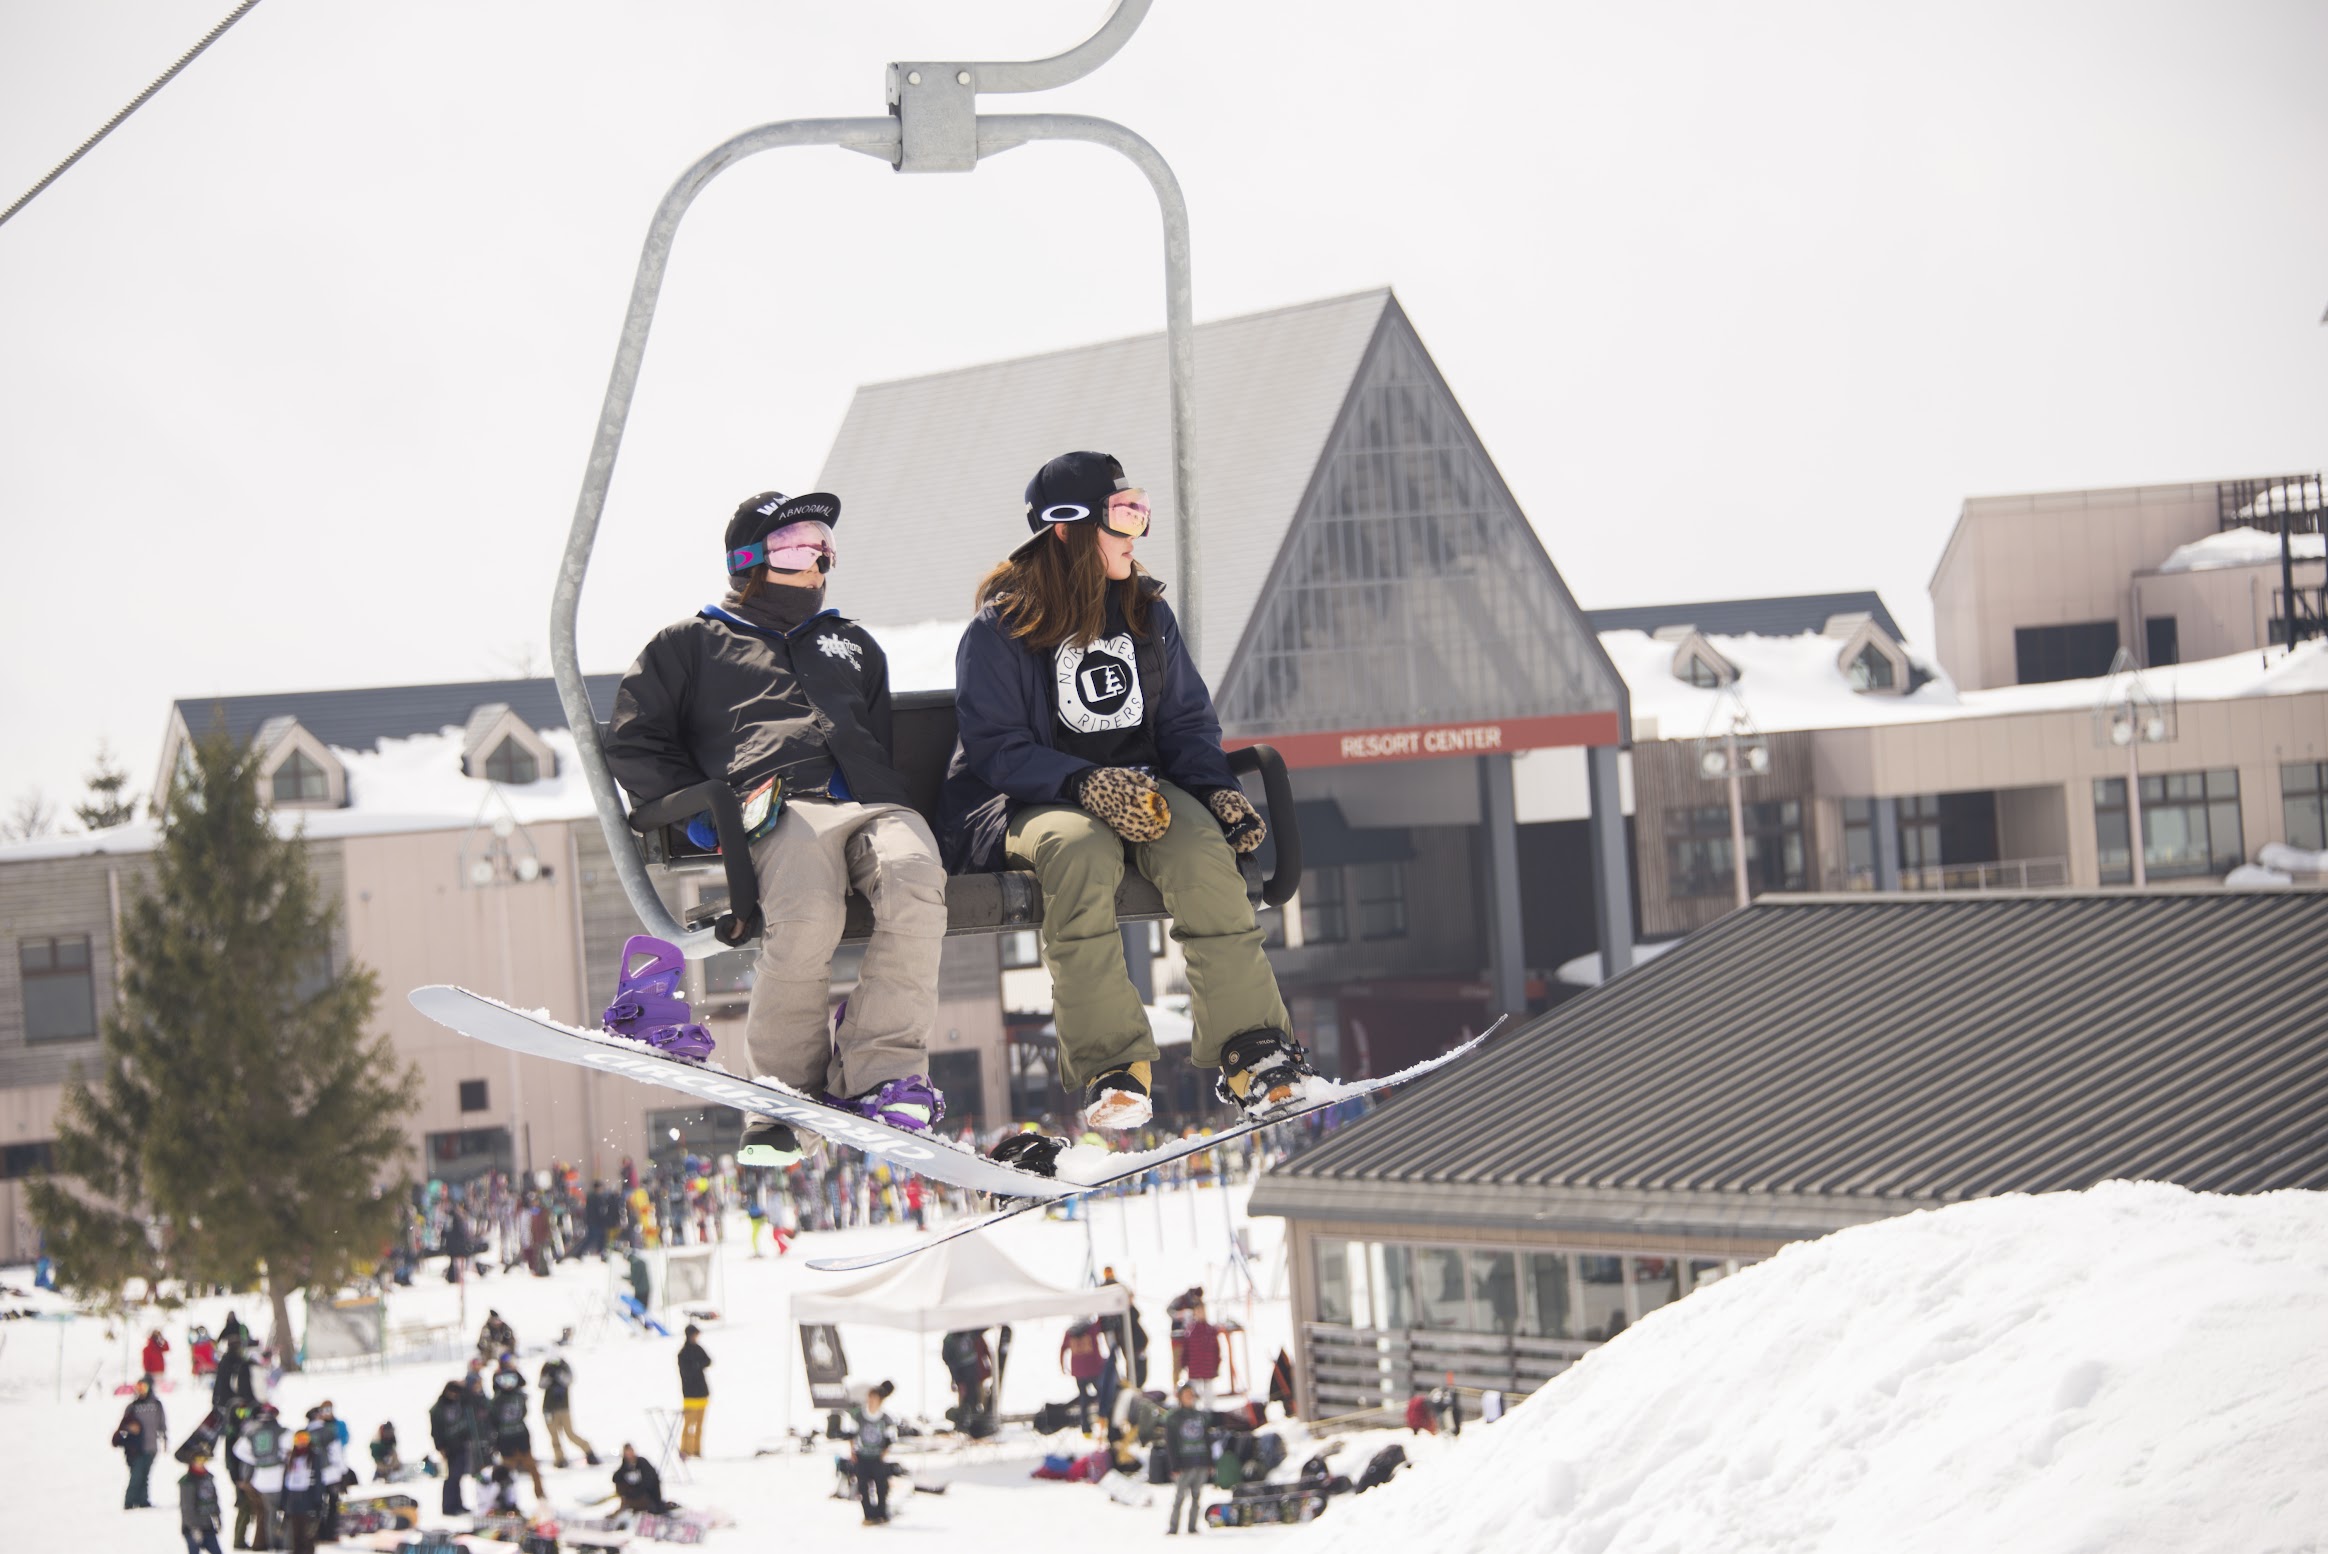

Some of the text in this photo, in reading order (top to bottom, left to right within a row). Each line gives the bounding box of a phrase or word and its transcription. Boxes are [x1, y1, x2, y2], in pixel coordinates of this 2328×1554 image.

[778, 504, 834, 520] ABNORMAL
[1077, 697, 1141, 731] RIDERS
[1341, 726, 1502, 758] RESORT CENTER
